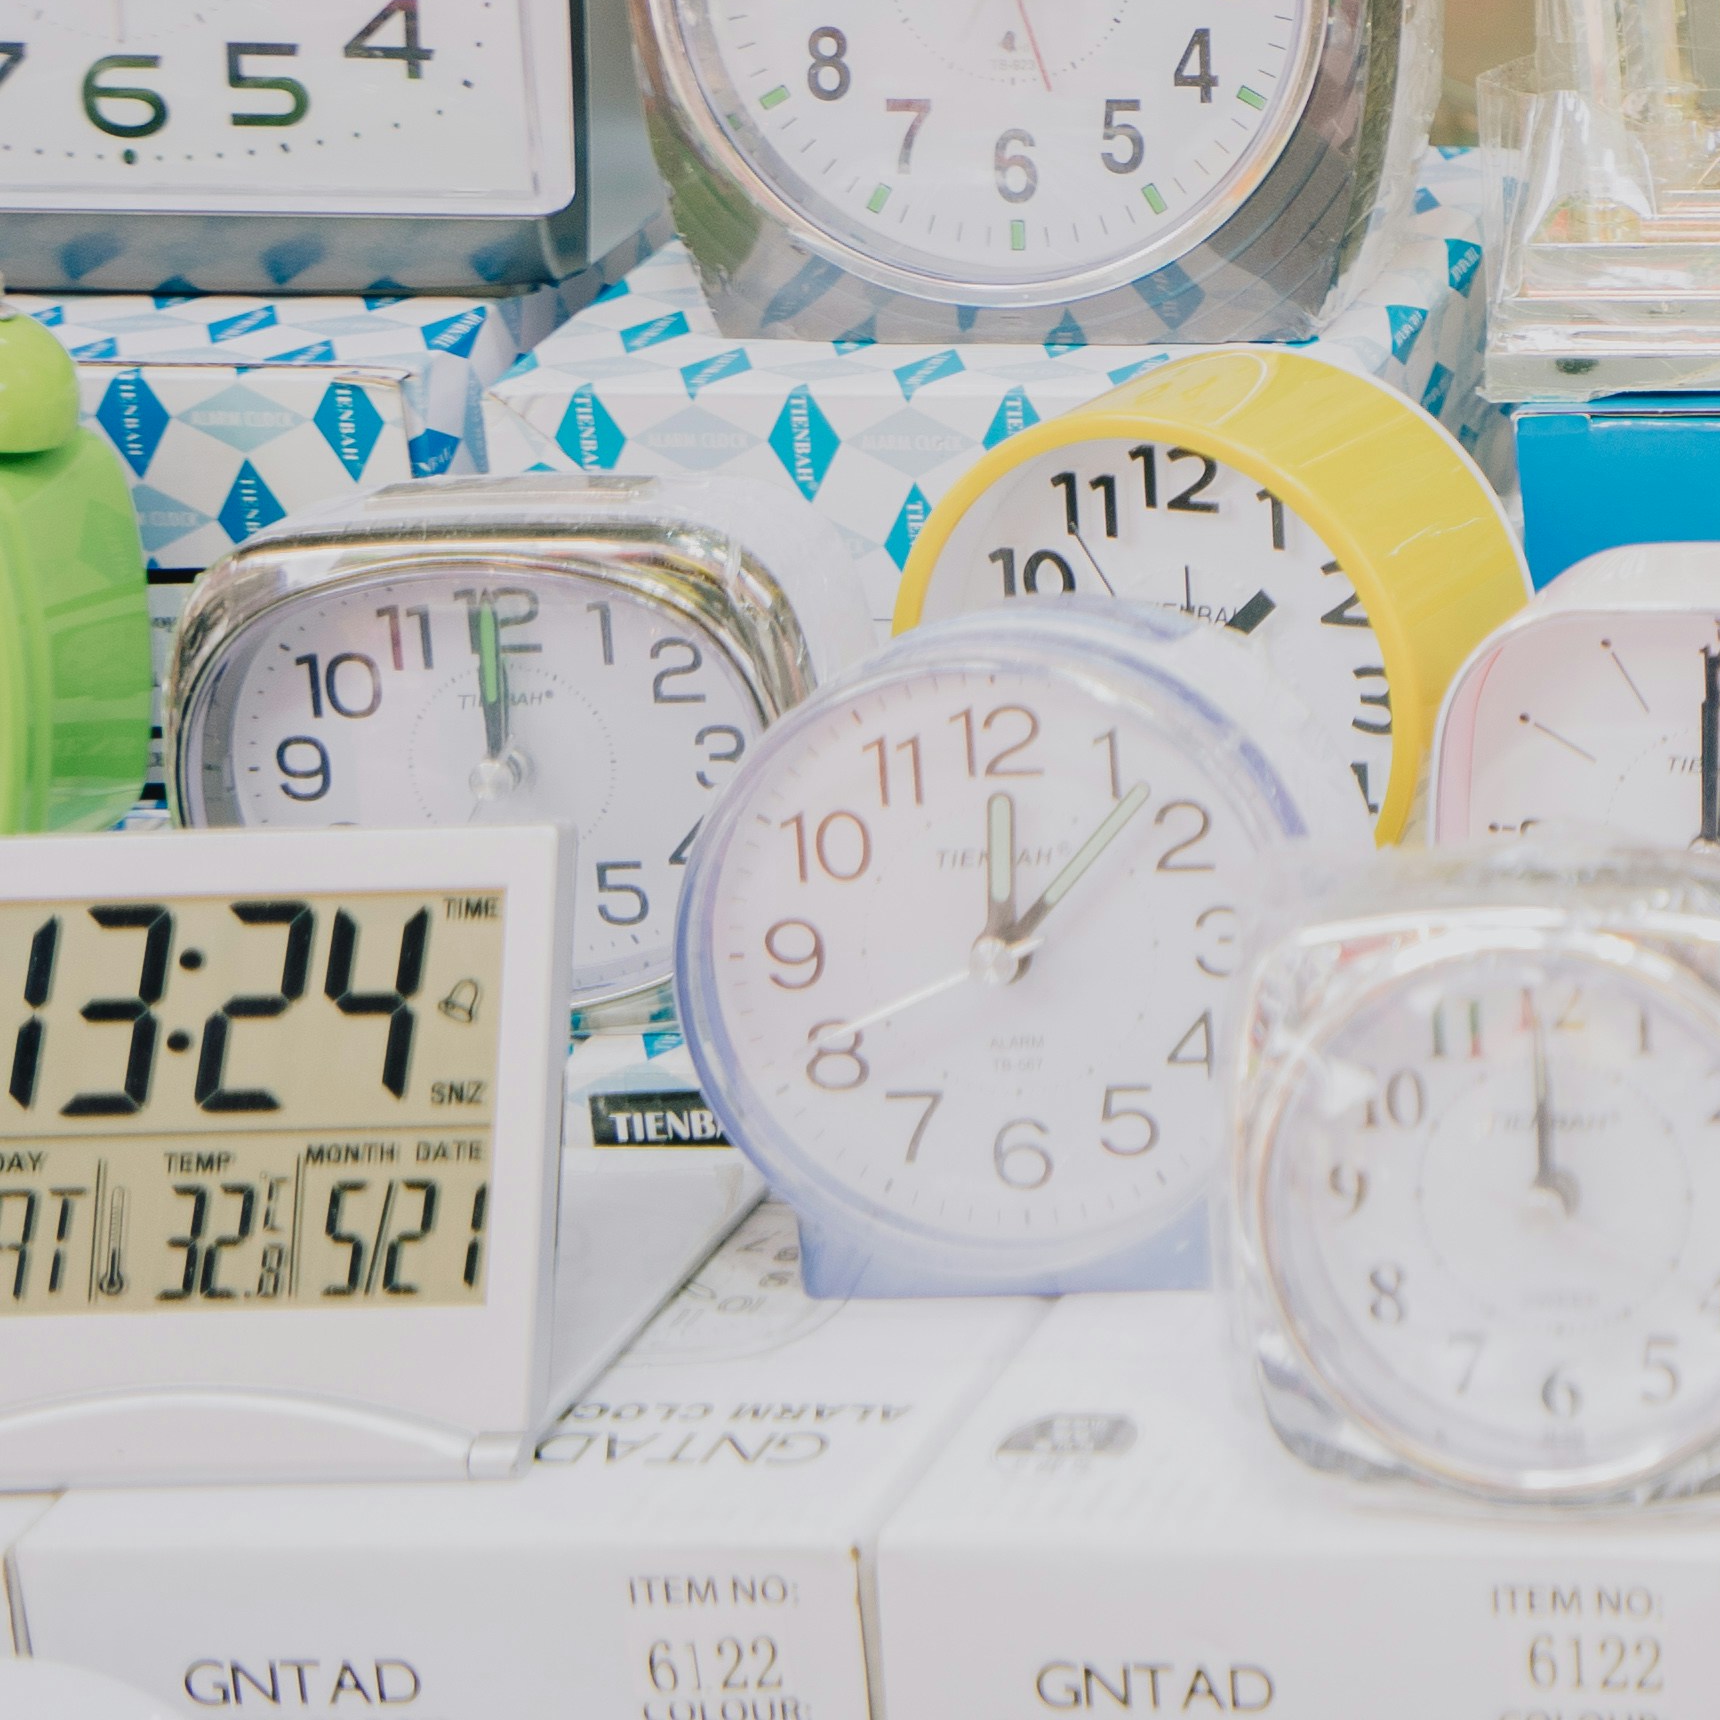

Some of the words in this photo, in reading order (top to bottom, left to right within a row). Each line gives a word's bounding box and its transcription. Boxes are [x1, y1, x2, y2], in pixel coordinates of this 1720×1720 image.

[82, 54, 169, 137] 6
[226, 42, 309, 126] 5
[807, 26, 851, 100] 8
[1173, 27, 1220, 104] 4
[885, 97, 932, 175] 7
[994, 128, 1038, 204] 6
[1099, 98, 1146, 174] 5
[1051, 472, 1118, 538] 11
[1129, 444, 1219, 512] 12
[988, 547, 1075, 598] 10
[376, 606, 434, 671] 11
[454, 587, 543, 653] 12
[586, 601, 615, 665] 1
[296, 653, 382, 719] 10
[649, 639, 706, 704] 2
[276, 736, 331, 801] 9
[862, 735, 924, 807] 11
[948, 706, 1044, 777] 12
[780, 810, 871, 883] 10
[1154, 800, 1215, 873] 2
[445, 897, 500, 920] TIME
[596, 861, 650, 925] 5
[764, 917, 826, 990] 9
[8, 900, 429, 1116] 13:24
[805, 1020, 870, 1091] 8
[430, 1083, 484, 1104] SNZ
[1100, 1085, 1160, 1157] 5
[305, 1142, 395, 1165] MONTH
[415, 1140, 483, 1162] DATE
[885, 1091, 943, 1163] 7
[994, 1118, 1052, 1189] 6
[164, 1152, 235, 1173] TEMP
[321, 1180, 487, 1297] 5/21
[1370, 1266, 1405, 1325] 8
[1540, 1361, 1582, 1418] 6
[1640, 1333, 1680, 1406] 5
[629, 1574, 718, 1605] ITEM
[731, 1575, 800, 1606] NO:
[1492, 1584, 1581, 1614] ITEM
[1597, 1587, 1663, 1618] NO:
[185, 1660, 422, 1707] GNTAD
[648, 1636, 783, 1692] 6122
[1036, 1662, 1275, 1711] GNTAD
[1528, 1634, 1664, 1693] 6122
